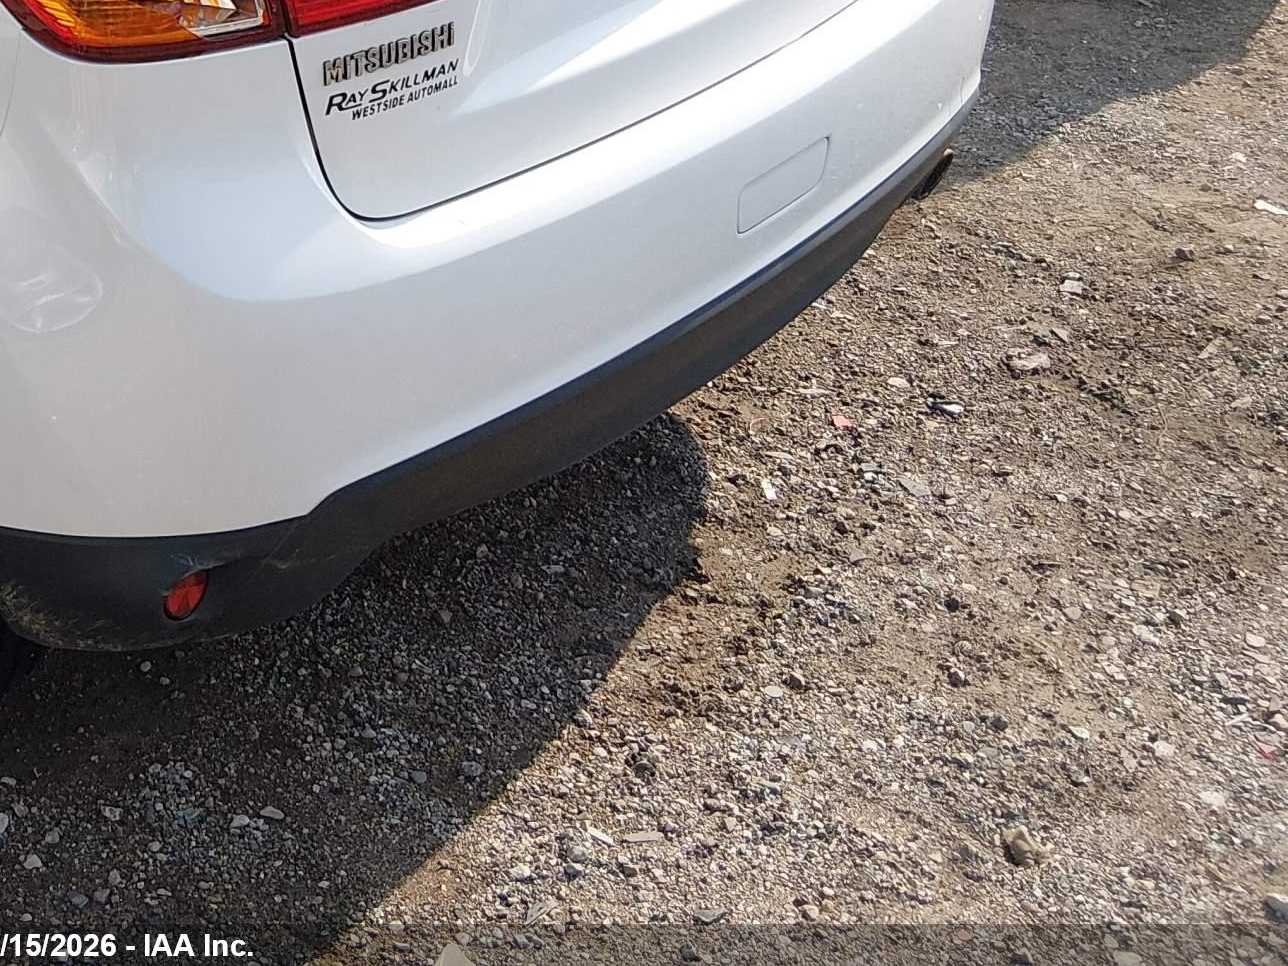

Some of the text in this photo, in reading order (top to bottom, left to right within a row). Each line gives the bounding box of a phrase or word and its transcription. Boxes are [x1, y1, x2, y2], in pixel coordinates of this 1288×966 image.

[323, 21, 455, 86] MITSUBISHI
[325, 58, 460, 116] RAY SKILLMAN
[352, 75, 458, 121] WESTSIDE AUTOMALL
